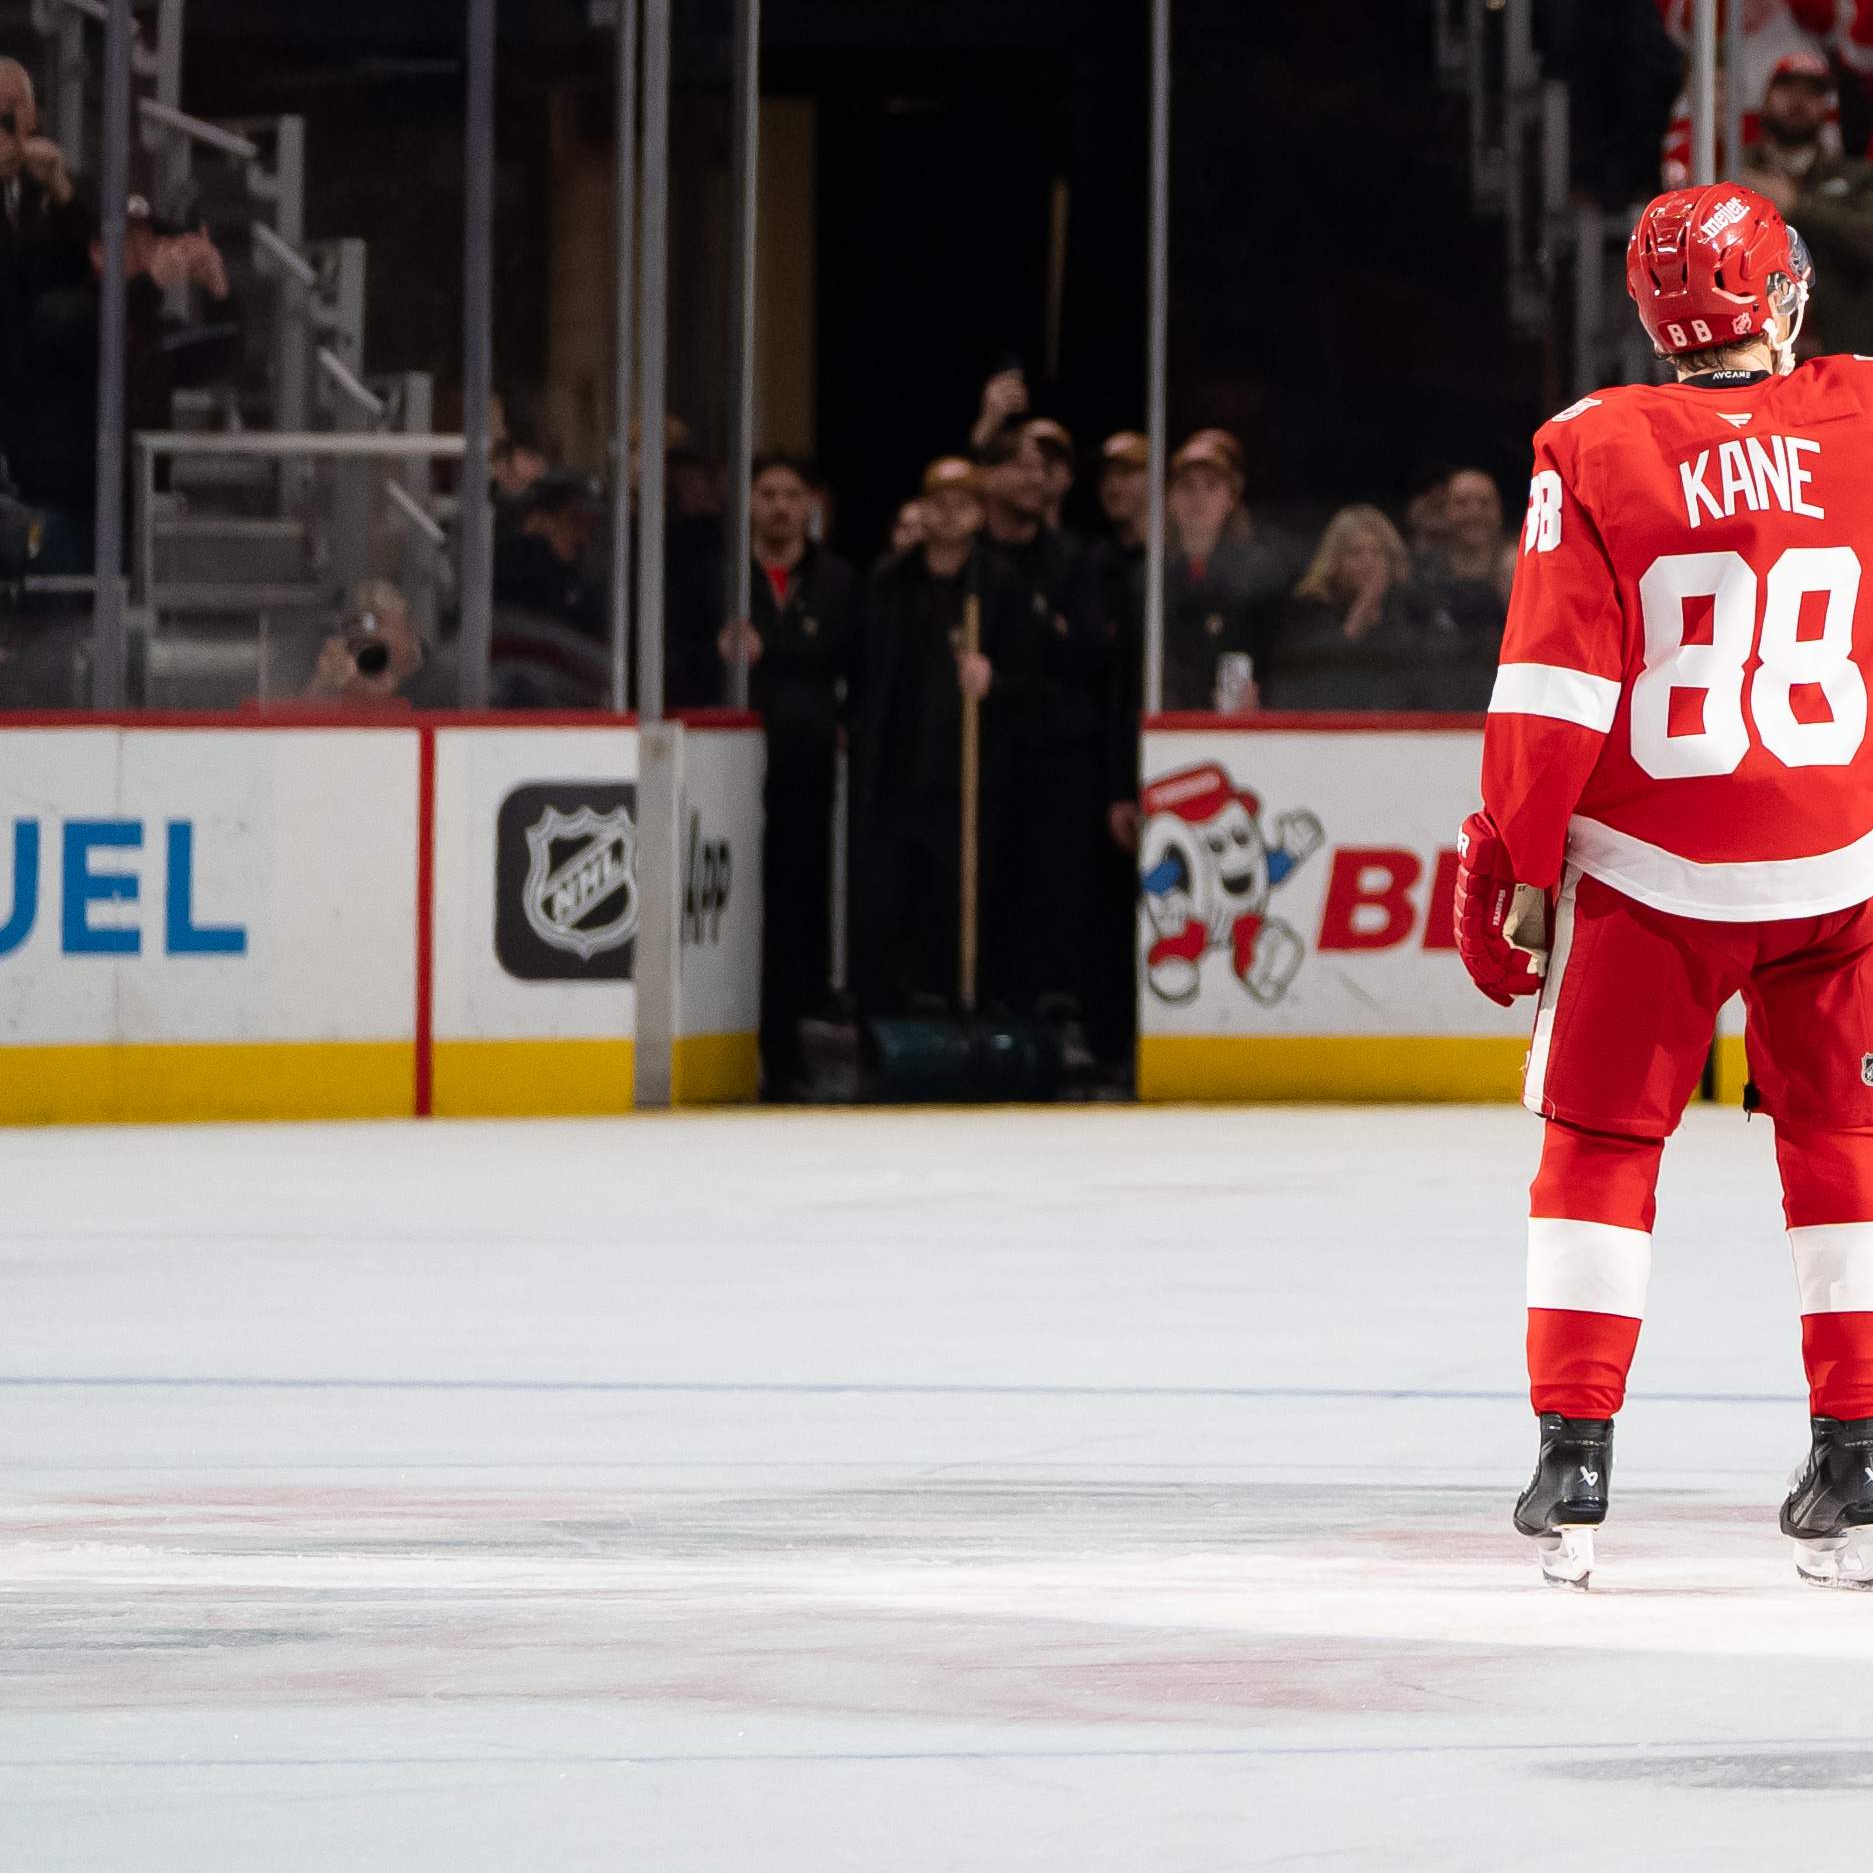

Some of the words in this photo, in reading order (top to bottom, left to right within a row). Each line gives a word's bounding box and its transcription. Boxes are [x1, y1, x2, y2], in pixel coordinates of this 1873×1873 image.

[1666, 319, 1713, 347] 88
[1679, 435, 1825, 529] KANE
[1630, 546, 1868, 780] 88
[551, 833, 630, 928] NHL
